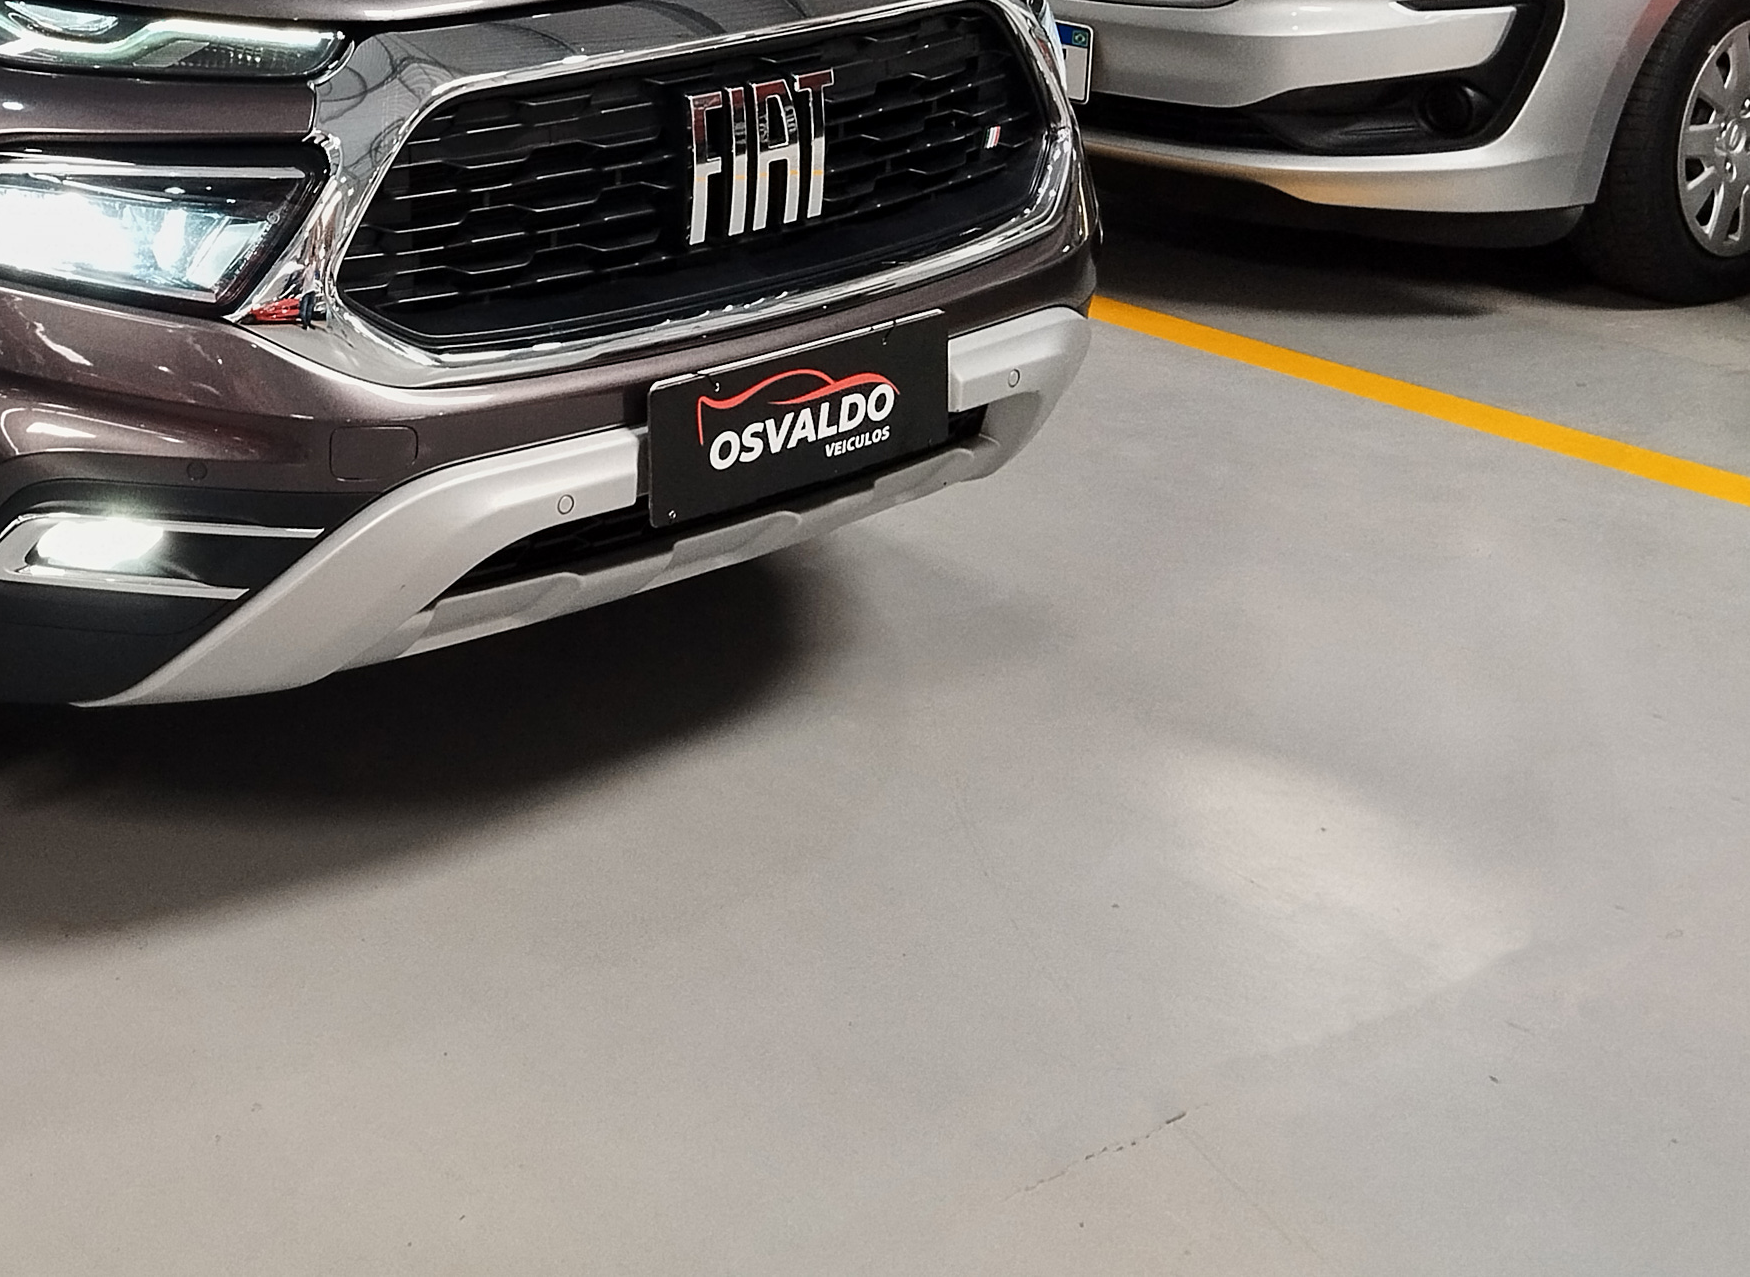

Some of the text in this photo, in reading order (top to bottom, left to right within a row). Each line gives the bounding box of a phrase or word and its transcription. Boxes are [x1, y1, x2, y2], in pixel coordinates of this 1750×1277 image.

[685, 68, 835, 246] FIAT
[708, 383, 896, 471] OSVALDO
[824, 425, 891, 458] VEICULOS
